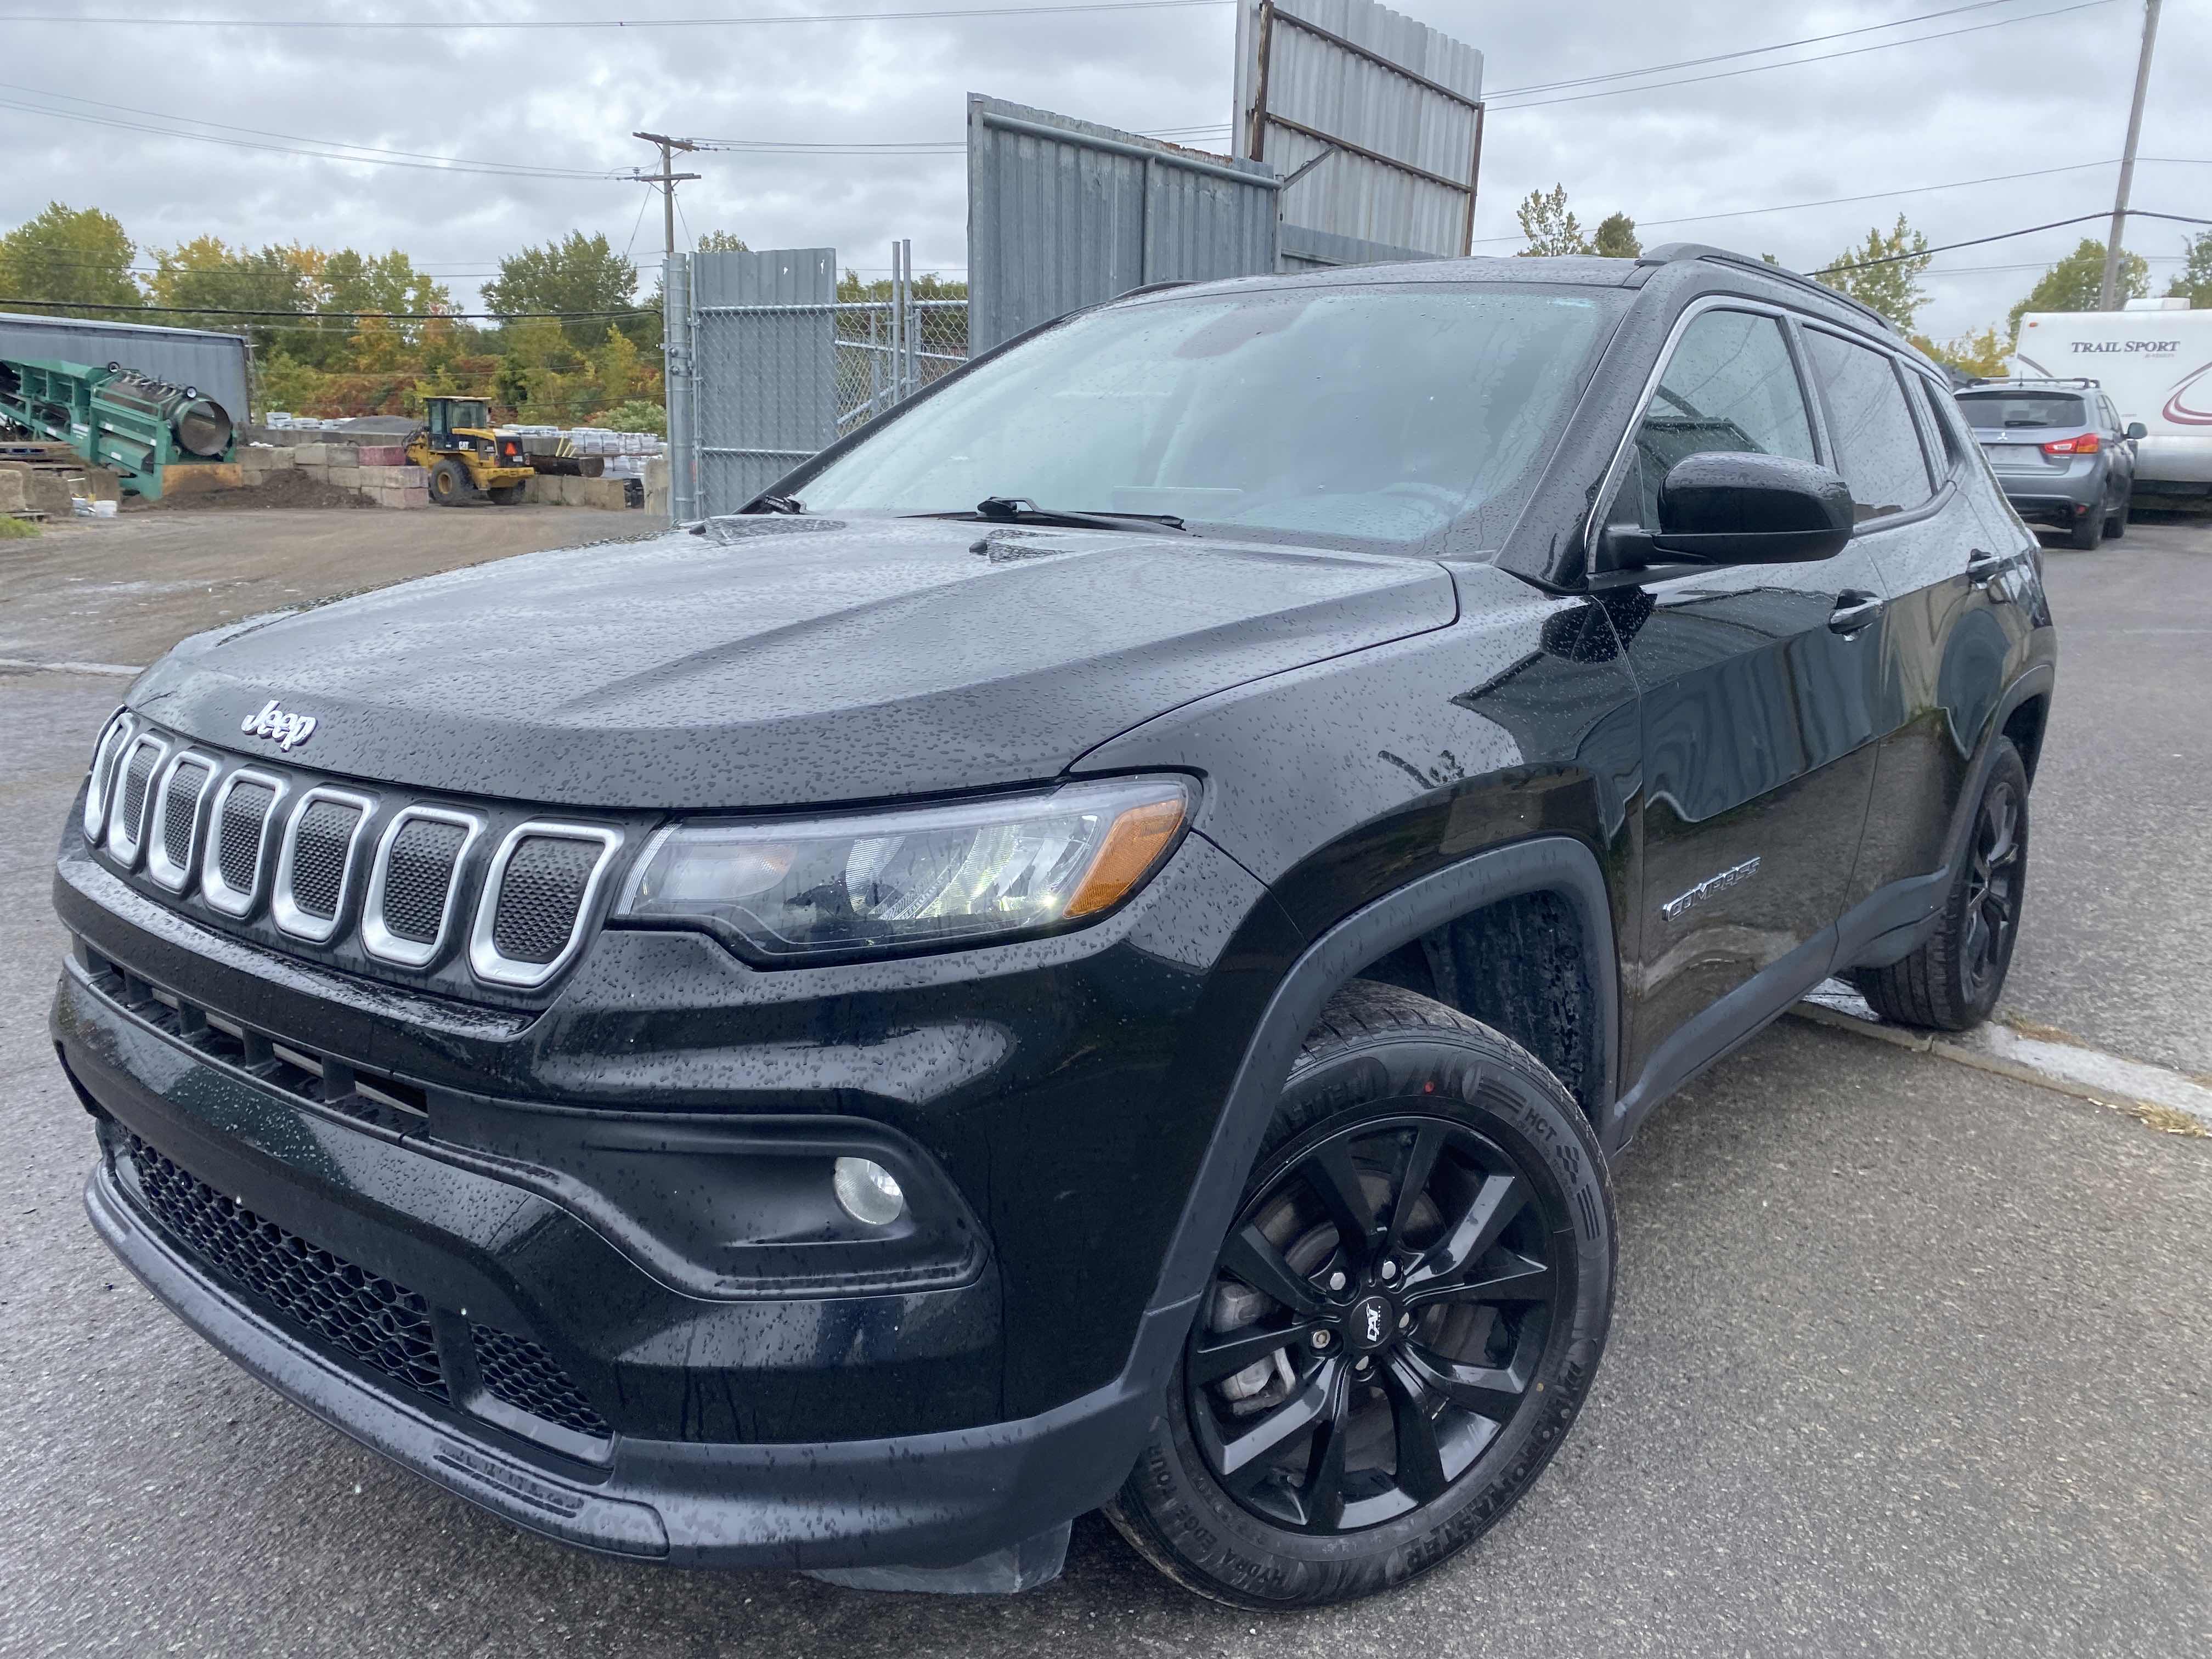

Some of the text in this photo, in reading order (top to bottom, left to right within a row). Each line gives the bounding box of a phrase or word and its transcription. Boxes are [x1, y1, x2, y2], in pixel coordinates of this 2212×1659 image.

[2072, 341, 2180, 353] TRAIL SPORT
[459, 441, 469, 451] CAT
[241, 699, 317, 753] Jeep
[1661, 856, 1762, 922] COMPASS
[1524, 1107, 1558, 1141] MCT
